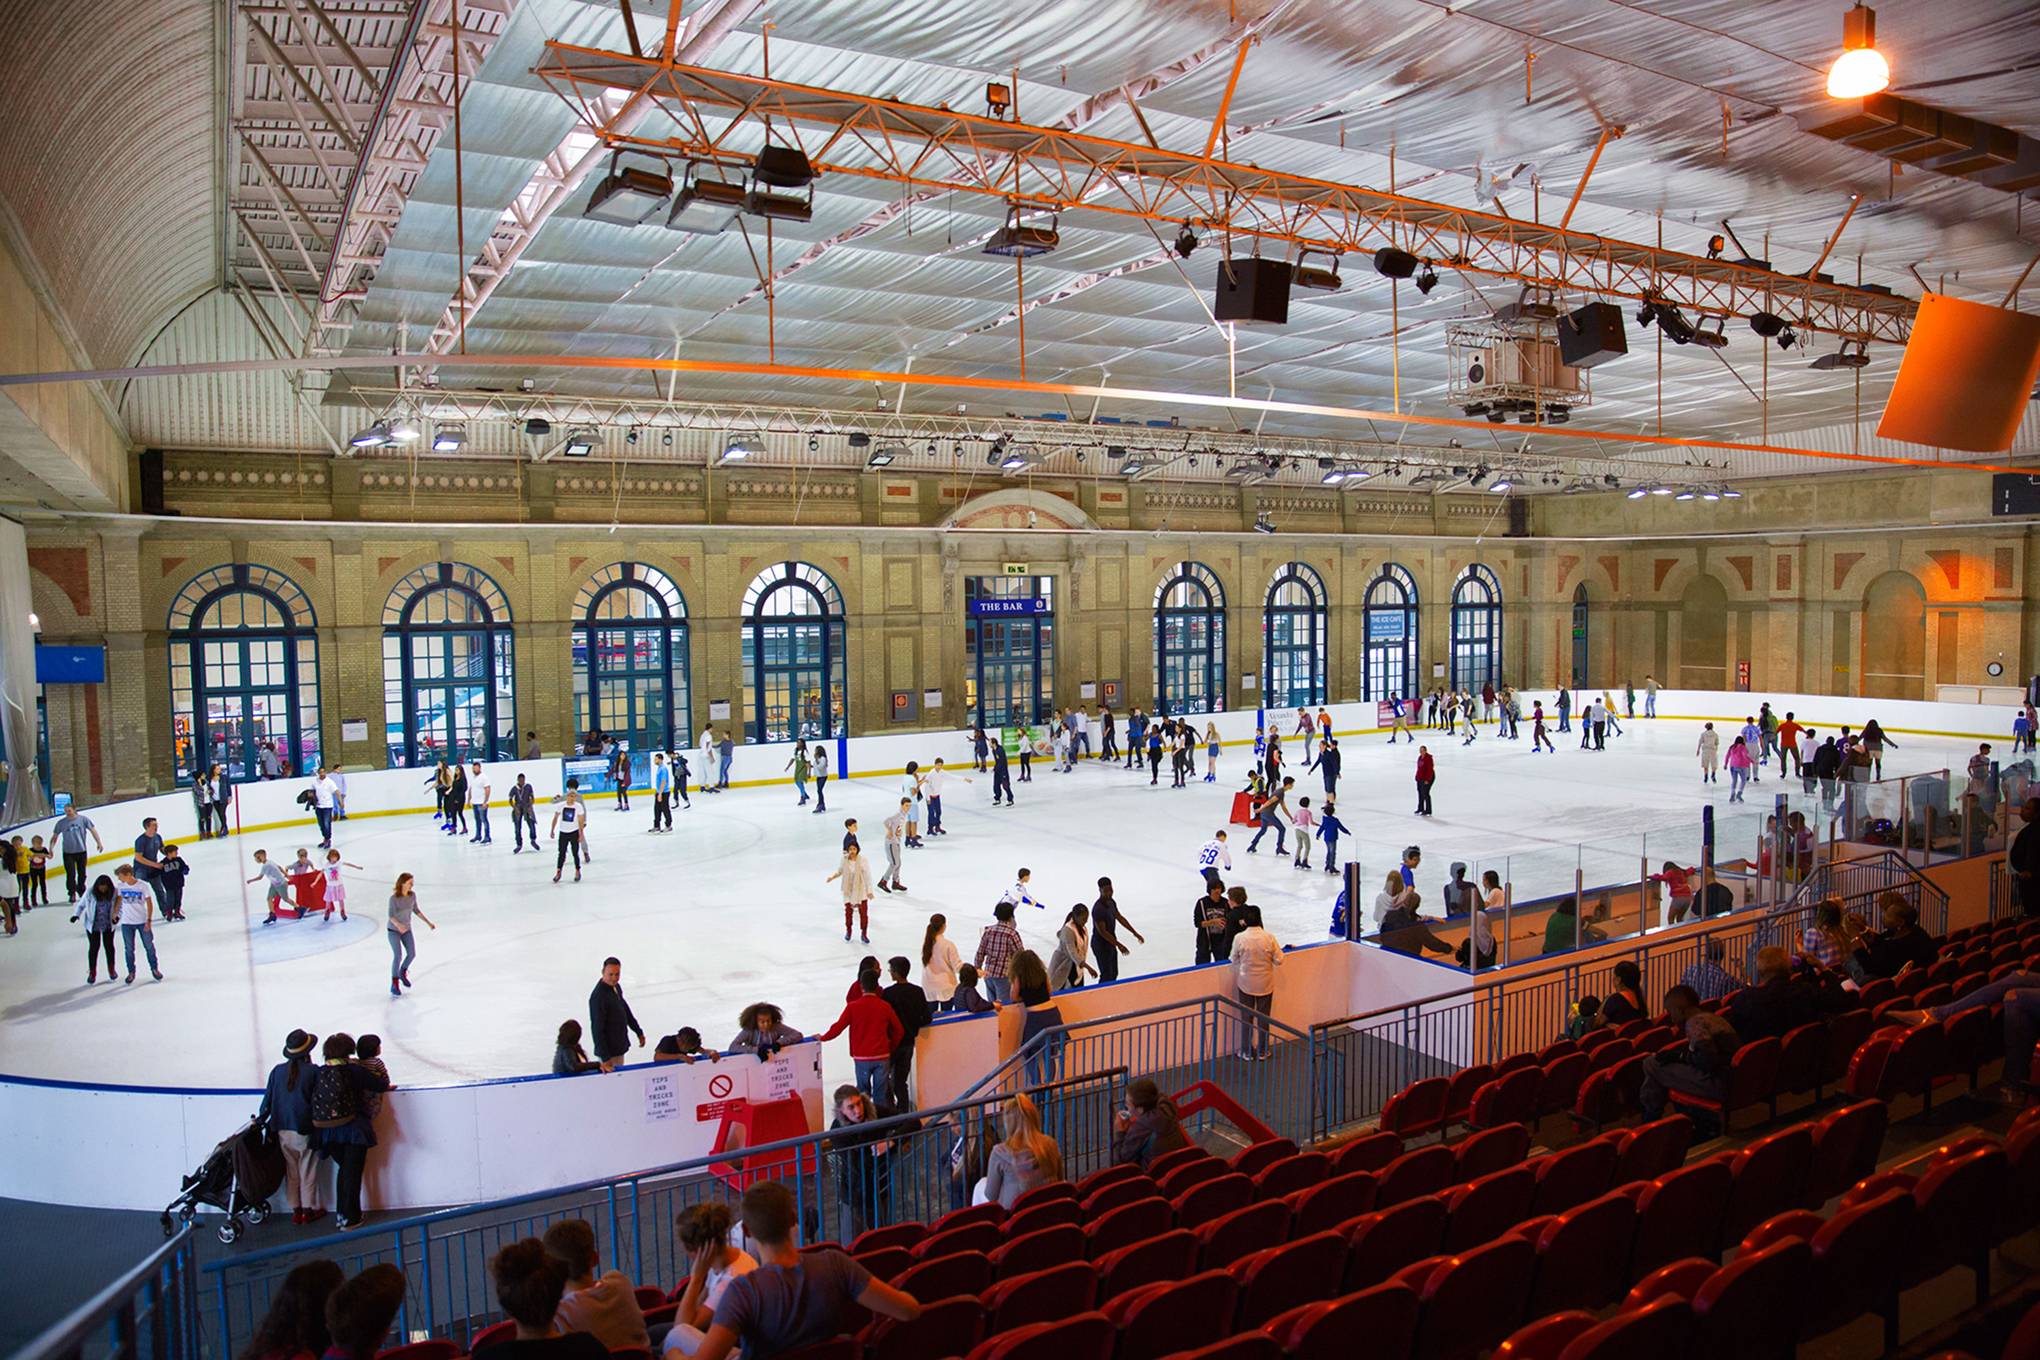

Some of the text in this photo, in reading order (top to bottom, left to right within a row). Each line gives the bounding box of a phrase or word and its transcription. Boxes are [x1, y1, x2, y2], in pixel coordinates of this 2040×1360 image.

[980, 602, 1023, 611] THE BAR
[1200, 848, 1218, 865] 68
[164, 861, 181, 872] GAP
[652, 1076, 668, 1084] TIPS
[648, 1092, 673, 1100] TRICKS
[653, 1100, 669, 1109] ZONE
